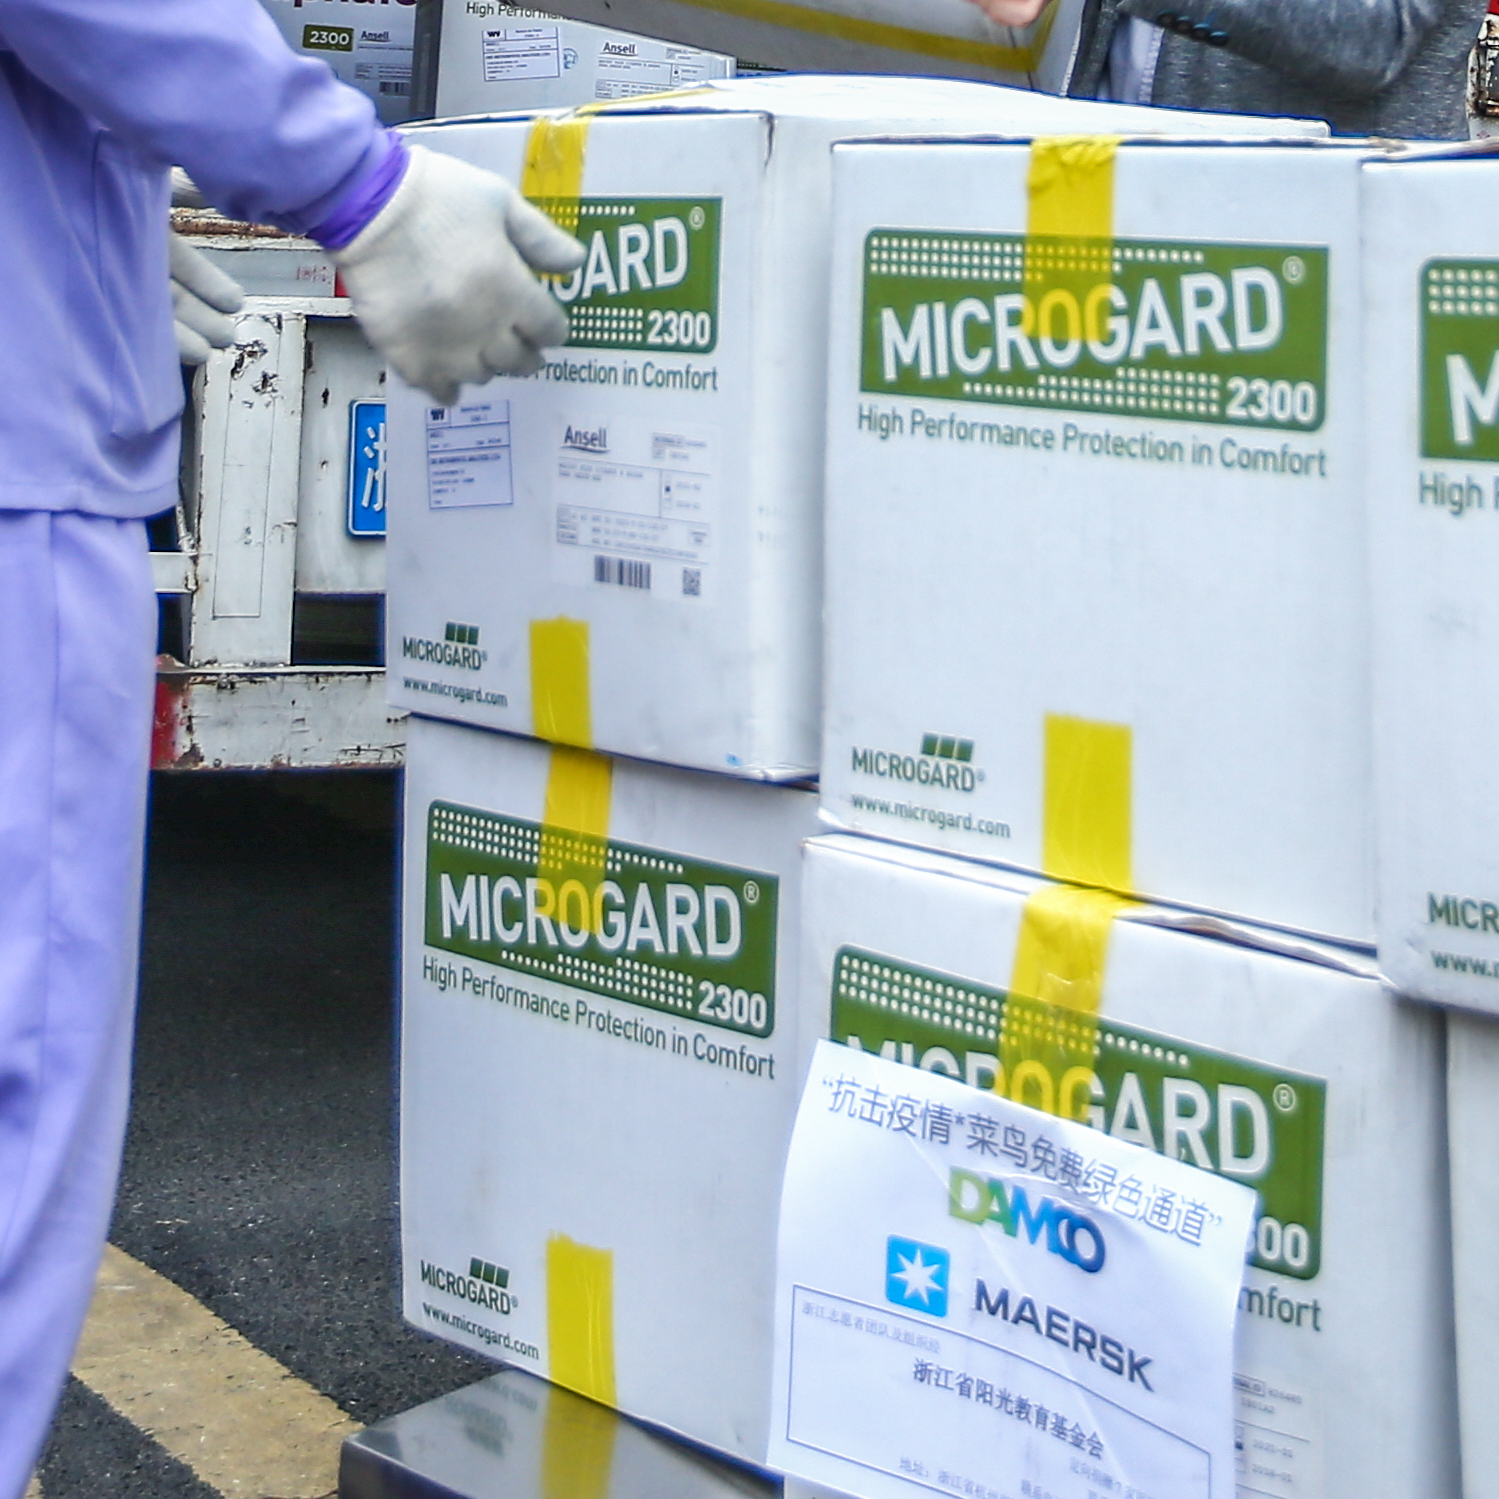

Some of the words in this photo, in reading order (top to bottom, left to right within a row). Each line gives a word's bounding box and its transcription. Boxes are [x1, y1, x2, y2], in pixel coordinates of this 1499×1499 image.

[466, 1, 494, 18] High
[309, 30, 350, 46] 2300
[361, 30, 390, 41] Ansell
[603, 42, 636, 55] Ansell
[647, 309, 712, 346] 2300
[535, 358, 618, 386] rotection
[623, 360, 638, 386] in
[643, 361, 718, 391] Comfort
[1225, 377, 1319, 423] 2300
[564, 424, 607, 448] Ansell
[857, 403, 905, 440] High
[911, 411, 1055, 451] Performance
[1062, 422, 1184, 464] Protection
[1192, 435, 1213, 467] in
[1219, 438, 1328, 478] Comfort
[1418, 471, 1486, 517] High
[403, 676, 508, 707] www.microgard.com
[850, 792, 1011, 839] www.microgard.com
[422, 955, 458, 993] High
[462, 965, 571, 1023] Performance
[575, 1000, 667, 1054] Protection
[672, 1026, 688, 1058] in
[693, 1033, 775, 1081] Comfort
[698, 979, 767, 1029] 2300
[948, 1166, 1105, 1272] DAMCO
[422, 1302, 540, 1360] www.microgard.com
[975, 1277, 1154, 1393] MAERSK
[912, 1357, 1104, 1460] 浙江省阳光教育基金会
